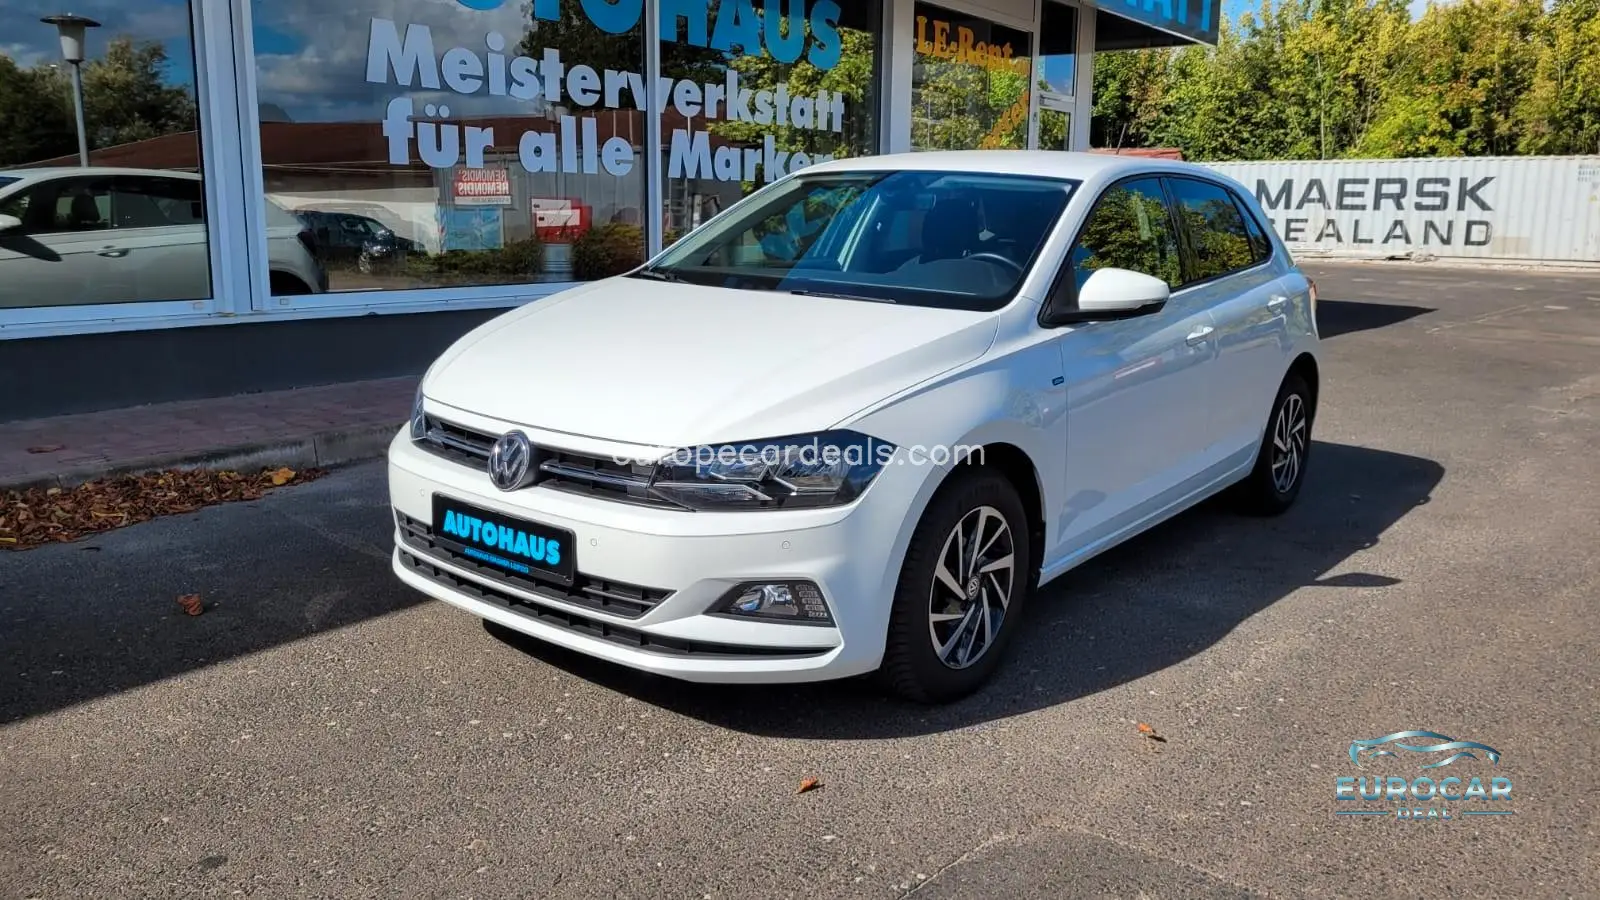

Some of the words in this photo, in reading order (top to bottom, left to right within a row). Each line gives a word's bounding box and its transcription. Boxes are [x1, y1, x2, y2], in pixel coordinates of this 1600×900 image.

[366, 17, 845, 133] Meisterwerkstatt
[382, 97, 494, 169] für
[518, 115, 634, 177] alle
[668, 128, 834, 183] Marke
[1256, 176, 1496, 211] MAERSK
[1268, 217, 1493, 246] EALAND
[443, 510, 560, 565] AUTOHAUS
